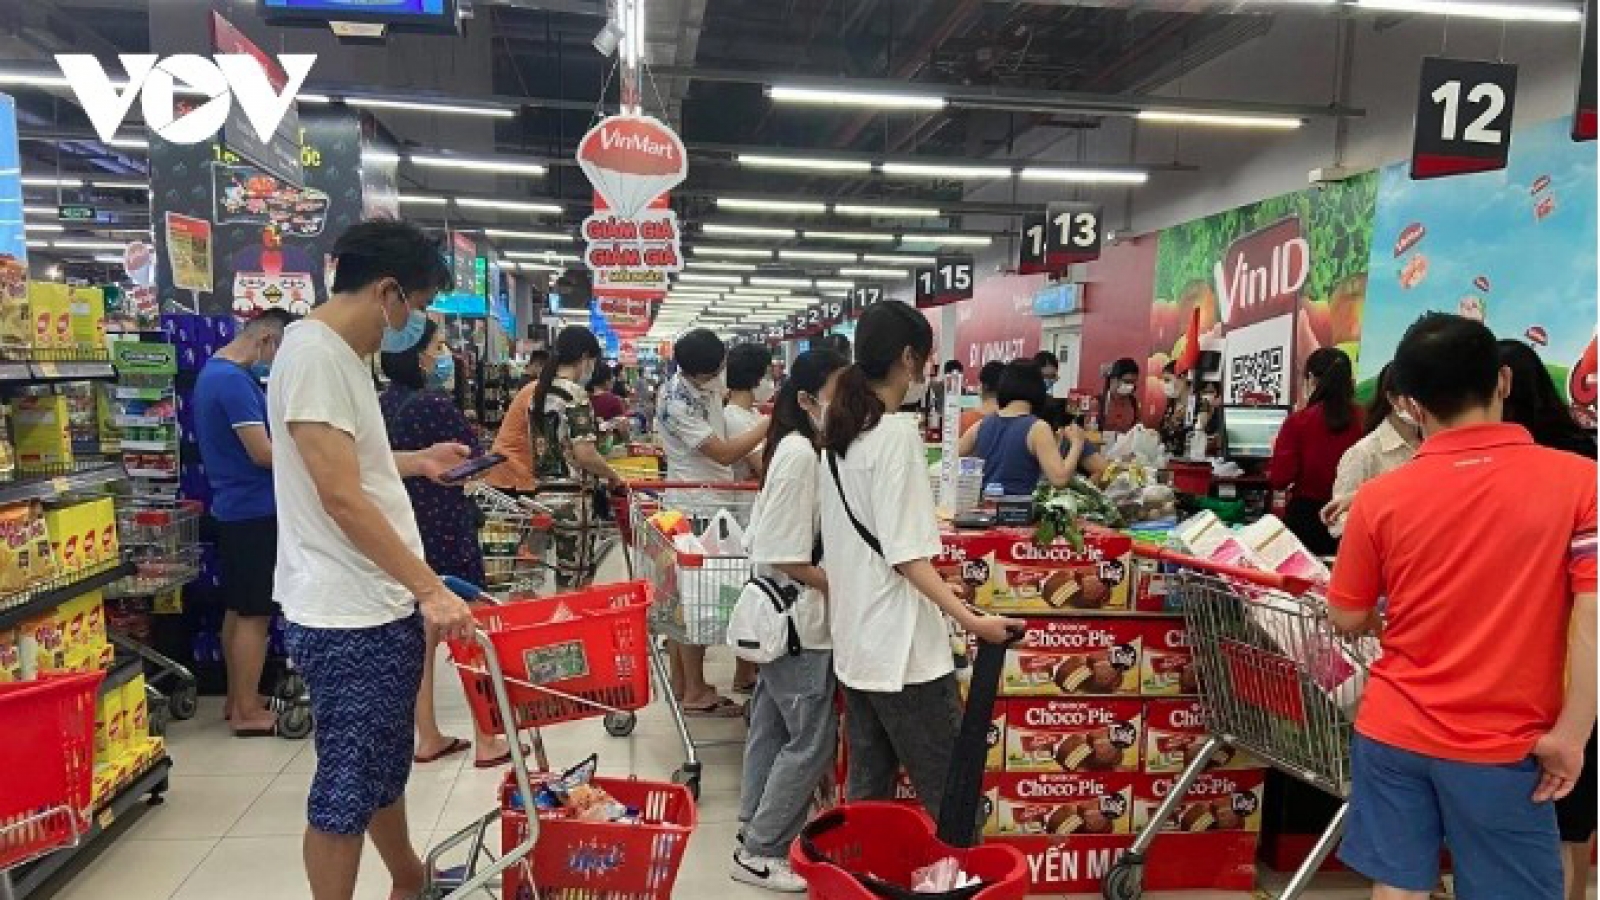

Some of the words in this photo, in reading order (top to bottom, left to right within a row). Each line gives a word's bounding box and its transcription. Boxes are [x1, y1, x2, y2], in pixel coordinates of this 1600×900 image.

[1431, 80, 1506, 143] 12
[600, 127, 673, 159] VinMart
[1026, 225, 1044, 256] 1
[1053, 212, 1097, 247] 13
[920, 272, 932, 295] 1
[939, 265, 971, 290] 15
[1213, 237, 1309, 323] VinID
[856, 288, 879, 306] 17
[809, 309, 820, 323] 2
[821, 303, 841, 318] 19
[797, 316, 806, 330] 2
[1152, 779, 1236, 796] Cco-Pie
